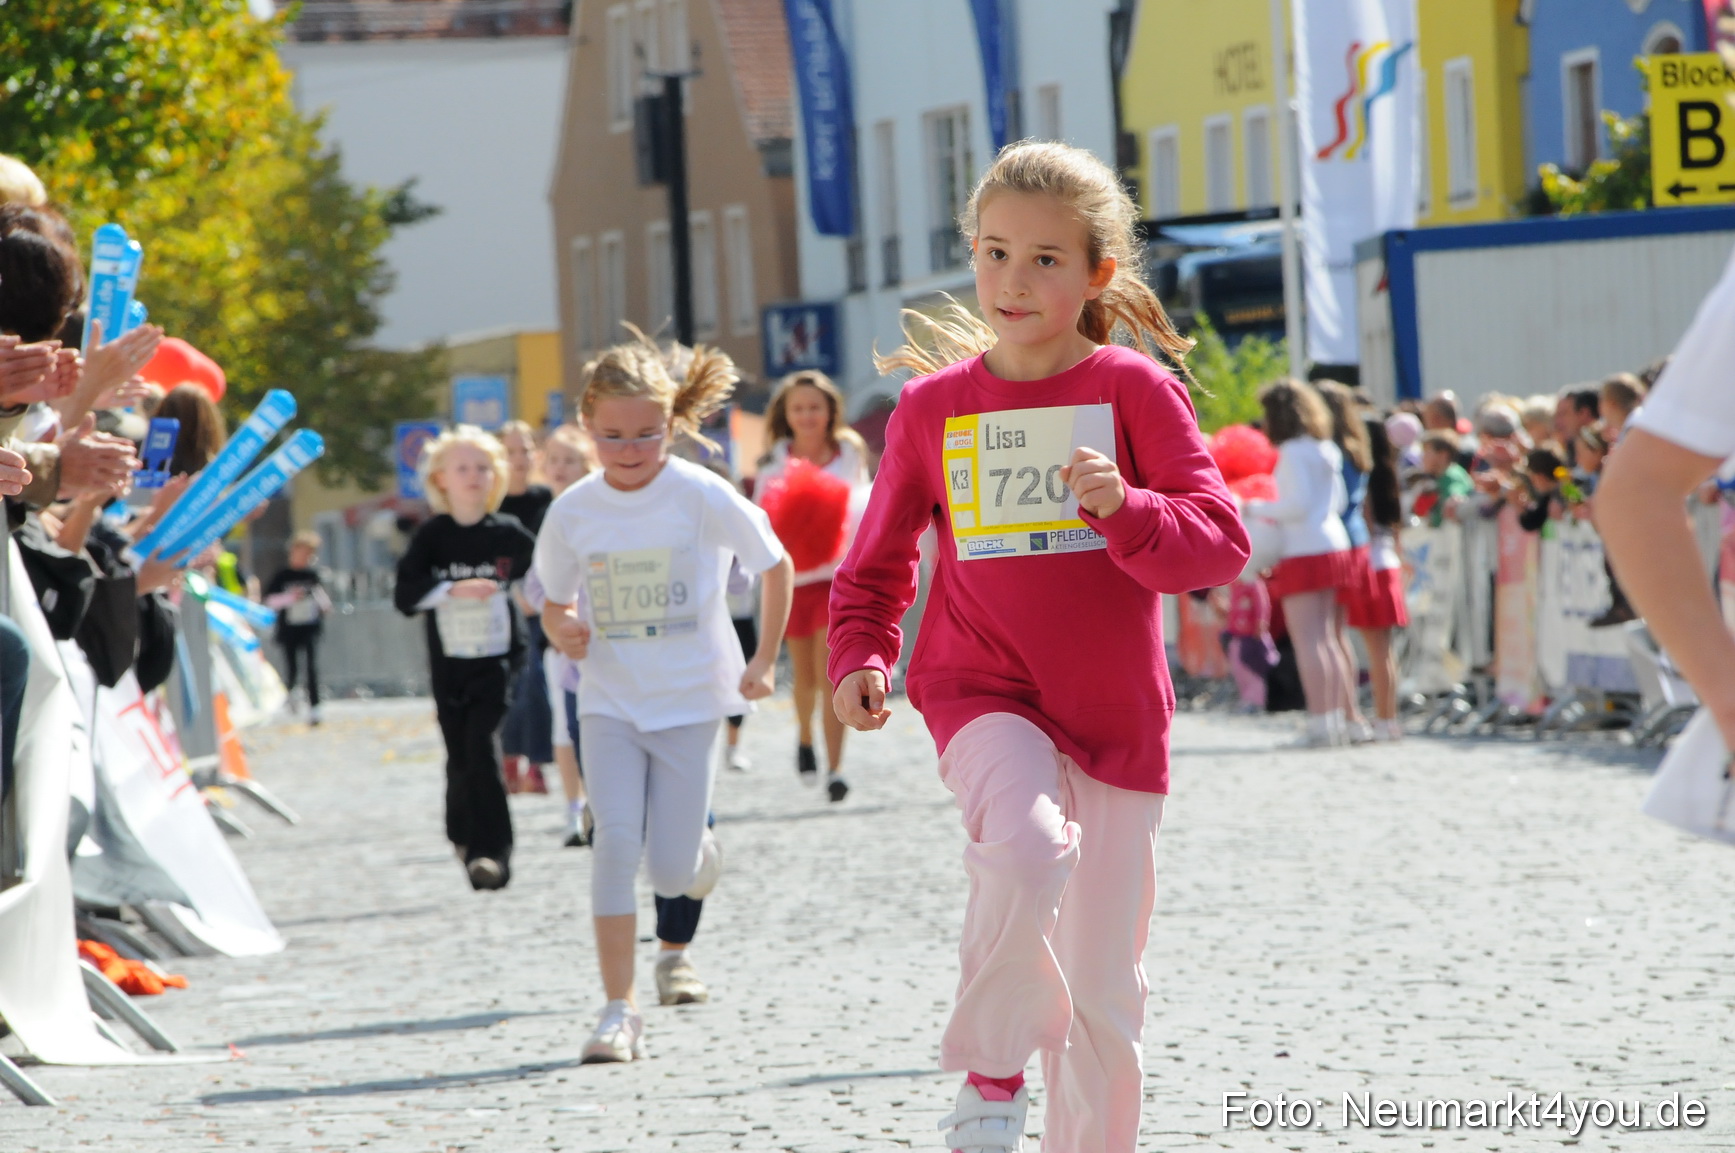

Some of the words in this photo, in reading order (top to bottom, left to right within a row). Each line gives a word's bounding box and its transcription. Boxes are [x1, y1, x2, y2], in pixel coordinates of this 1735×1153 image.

[1213, 42, 1266, 97] HOTEL
[1678, 101, 1725, 169] B
[985, 423, 1026, 450] Lisa
[951, 469, 969, 490] K3
[968, 538, 1004, 551] BOCK
[618, 580, 688, 610] 7089
